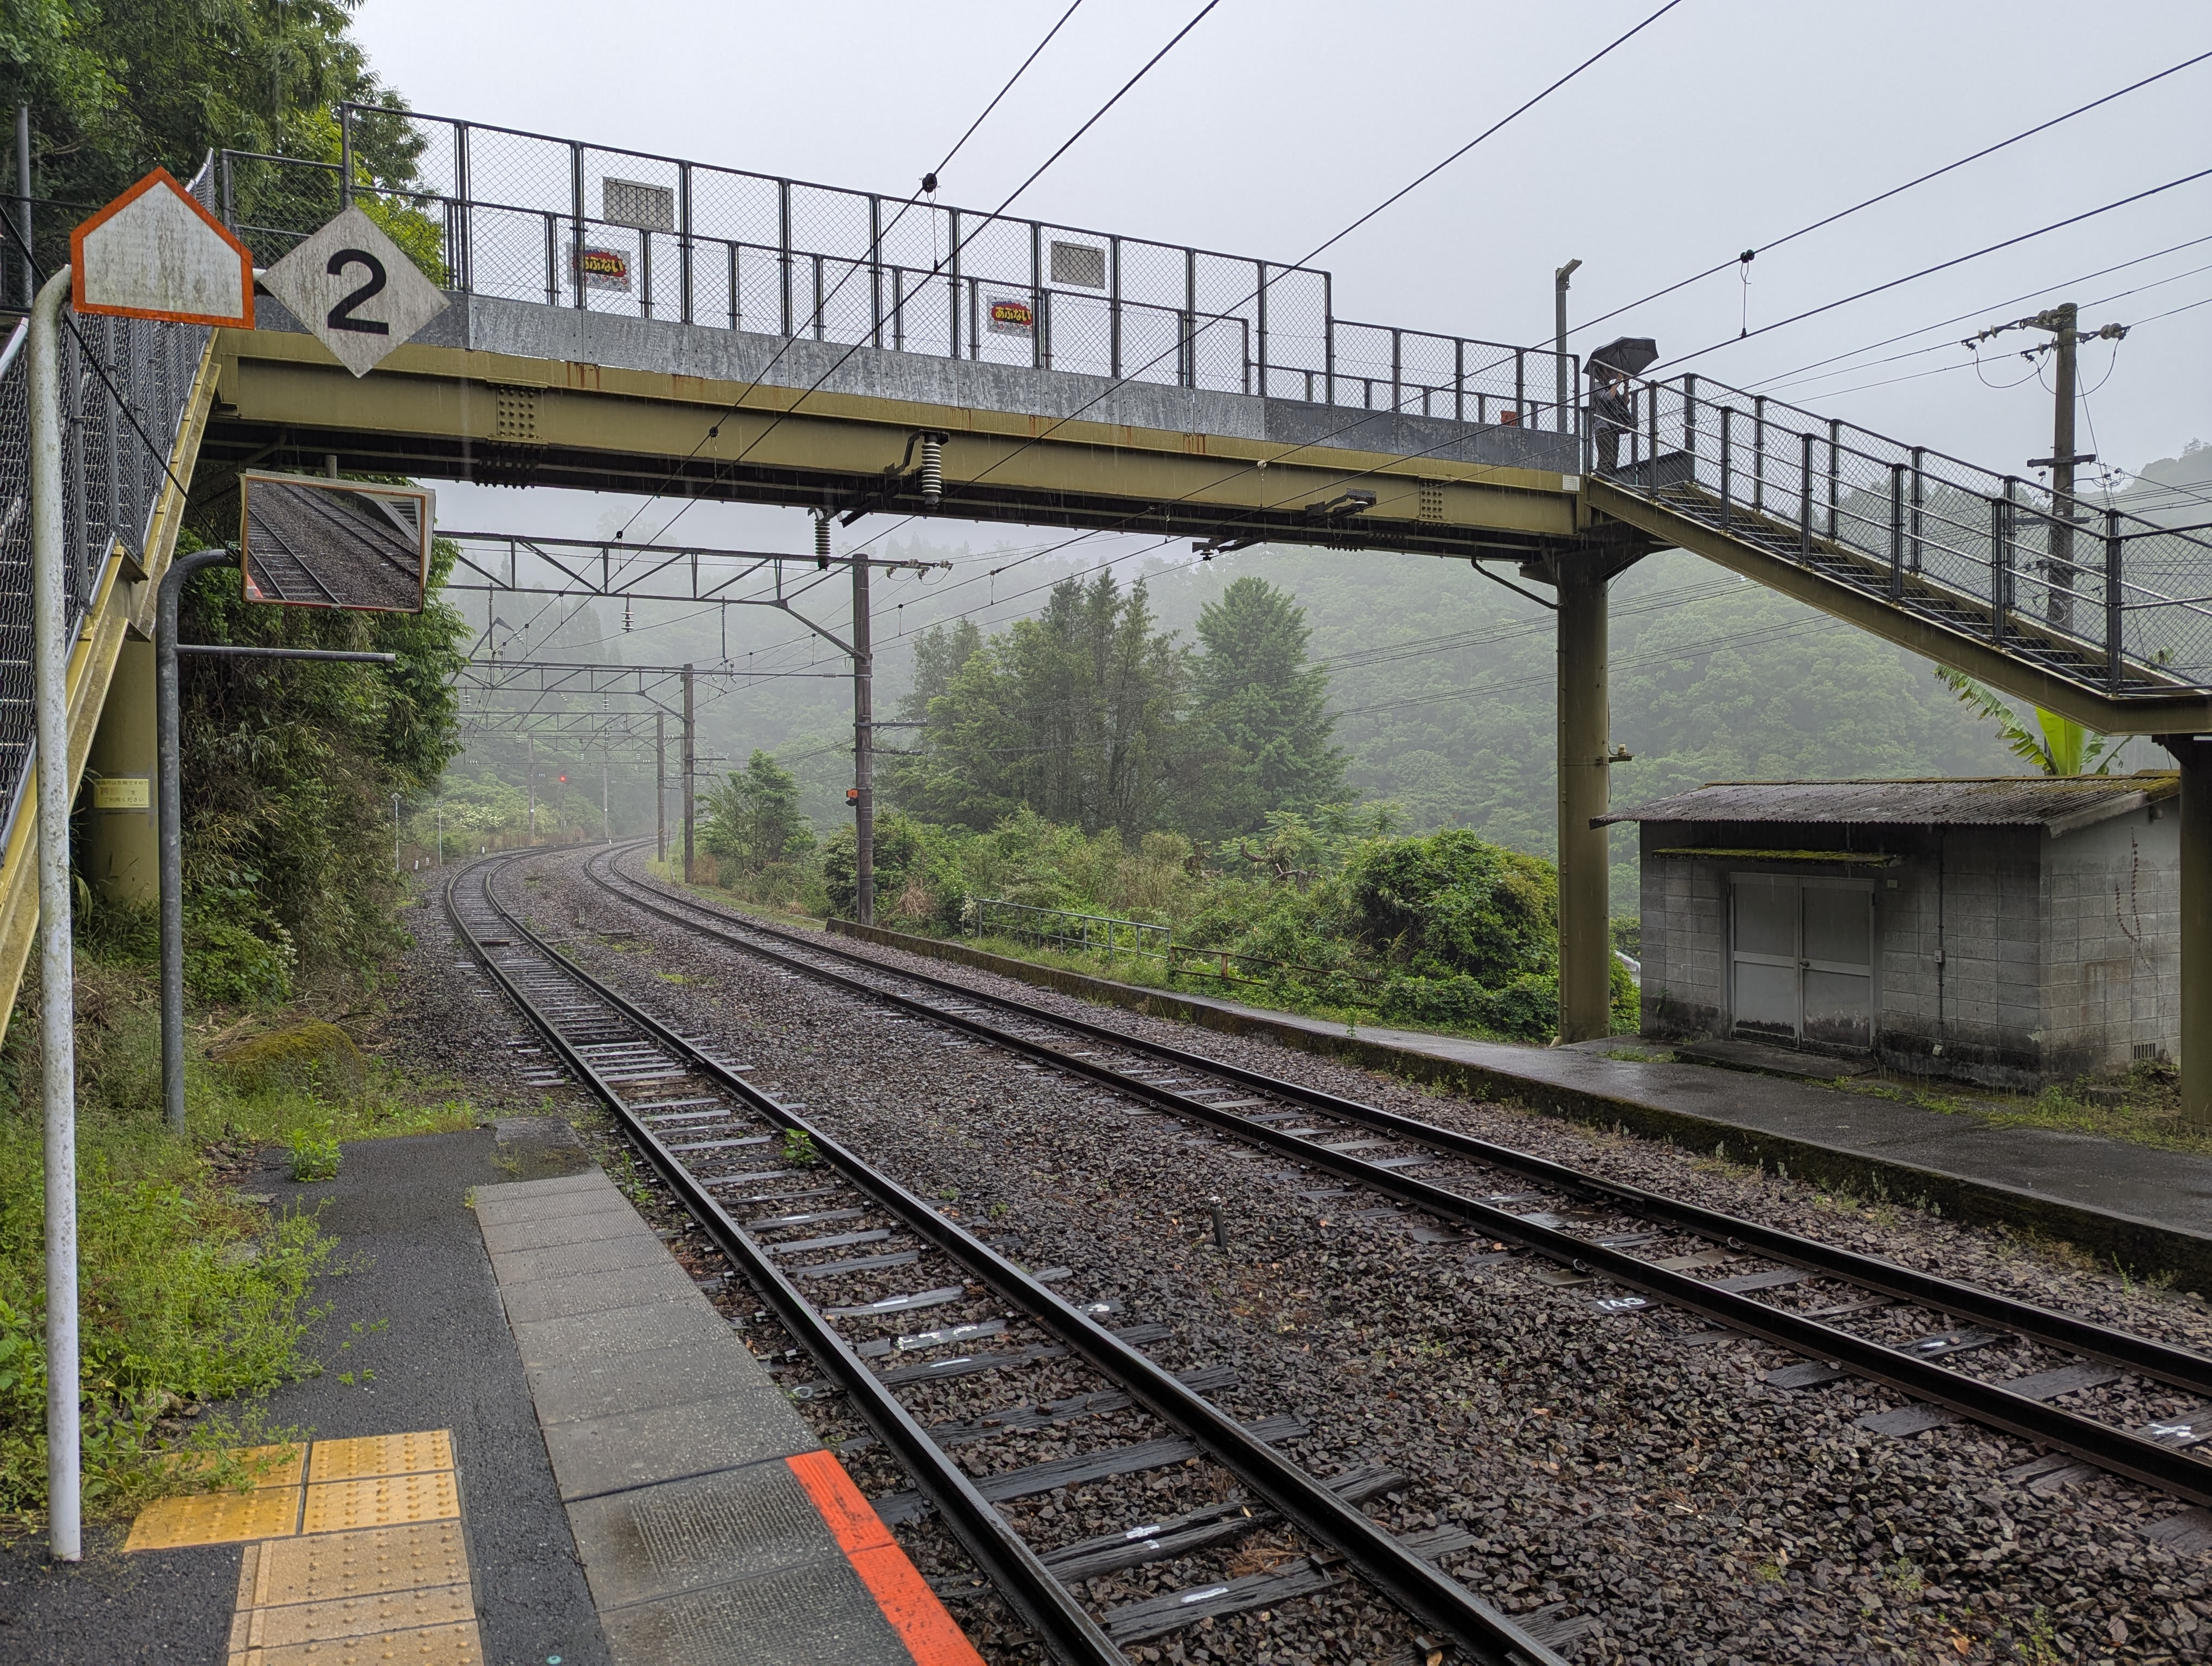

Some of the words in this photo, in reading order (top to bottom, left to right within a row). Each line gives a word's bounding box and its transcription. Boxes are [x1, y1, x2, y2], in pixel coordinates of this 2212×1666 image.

[326, 248, 389, 336] 2
[995, 306, 1031, 322] あぶない
